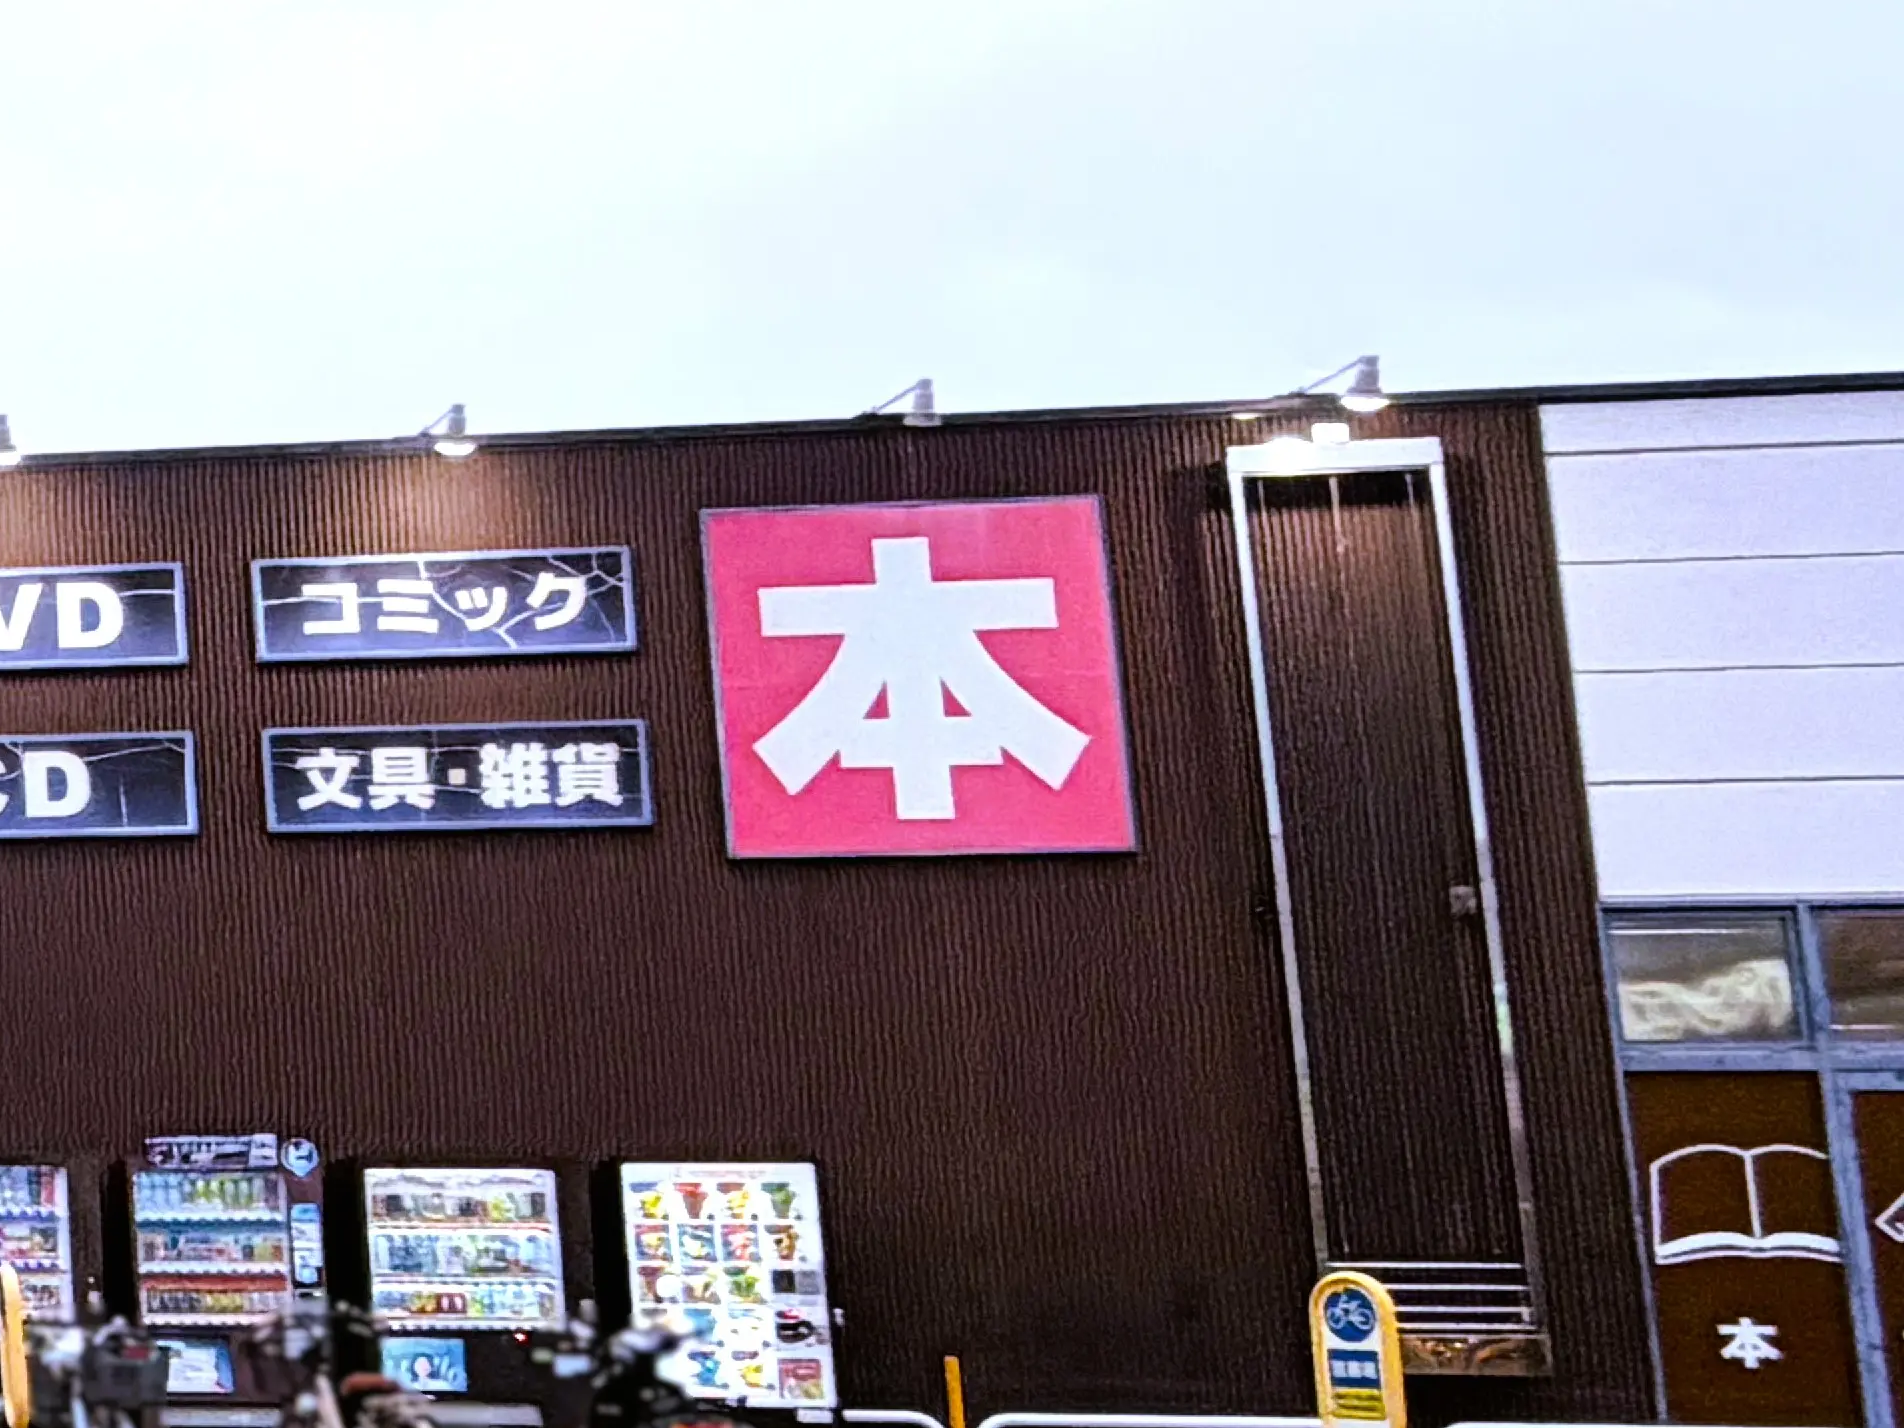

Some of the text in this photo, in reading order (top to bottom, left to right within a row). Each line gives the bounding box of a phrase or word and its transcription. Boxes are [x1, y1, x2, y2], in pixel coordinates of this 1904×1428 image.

[300, 571, 588, 635] コミック
[752, 536, 1093, 820] 本
[295, 741, 624, 811] 文具・雑貨
[1716, 1316, 1785, 1369] 本
